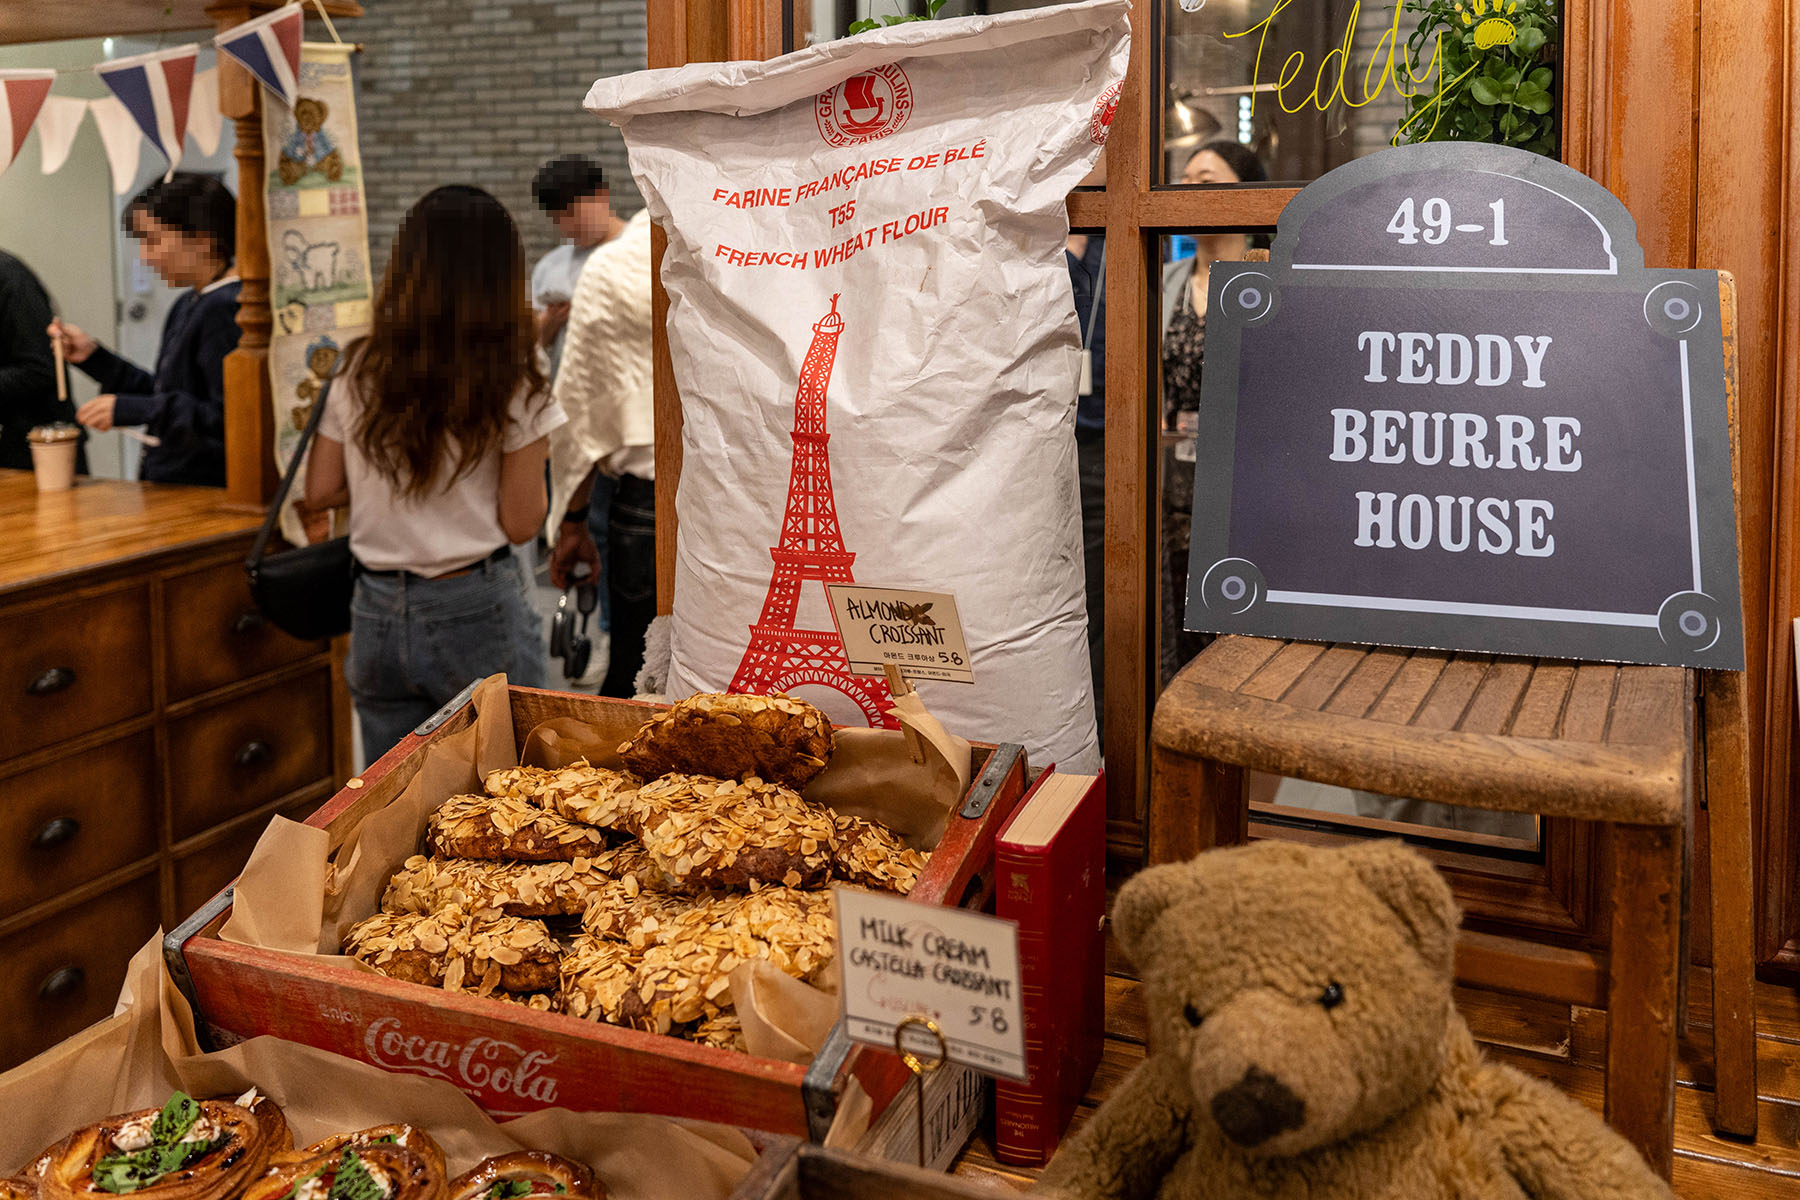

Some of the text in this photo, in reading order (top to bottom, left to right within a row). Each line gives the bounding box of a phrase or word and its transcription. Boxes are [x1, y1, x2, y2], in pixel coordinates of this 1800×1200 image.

[1222, 0, 1480, 148] Teddy
[712, 138, 987, 209] FARINE FRANÇAISE DE BLÉ
[714, 206, 950, 271] FRENCH WHEAT FLOUR
[827, 199, 857, 230] T55
[1385, 196, 1510, 247] 49-1
[1357, 330, 1553, 389] TEDDY
[1328, 407, 1583, 473] BEURRE
[1353, 490, 1556, 558] HOUSE
[846, 597, 914, 622] ALMOND
[869, 623, 945, 646] CROISSANT
[883, 651, 935, 662] 아몬드 크루아상
[938, 651, 964, 666] 5.8
[860, 916, 913, 948] MILK
[922, 931, 990, 969] CREAM
[850, 946, 925, 980] CASTELLA
[932, 962, 1011, 1000] CROISSANT
